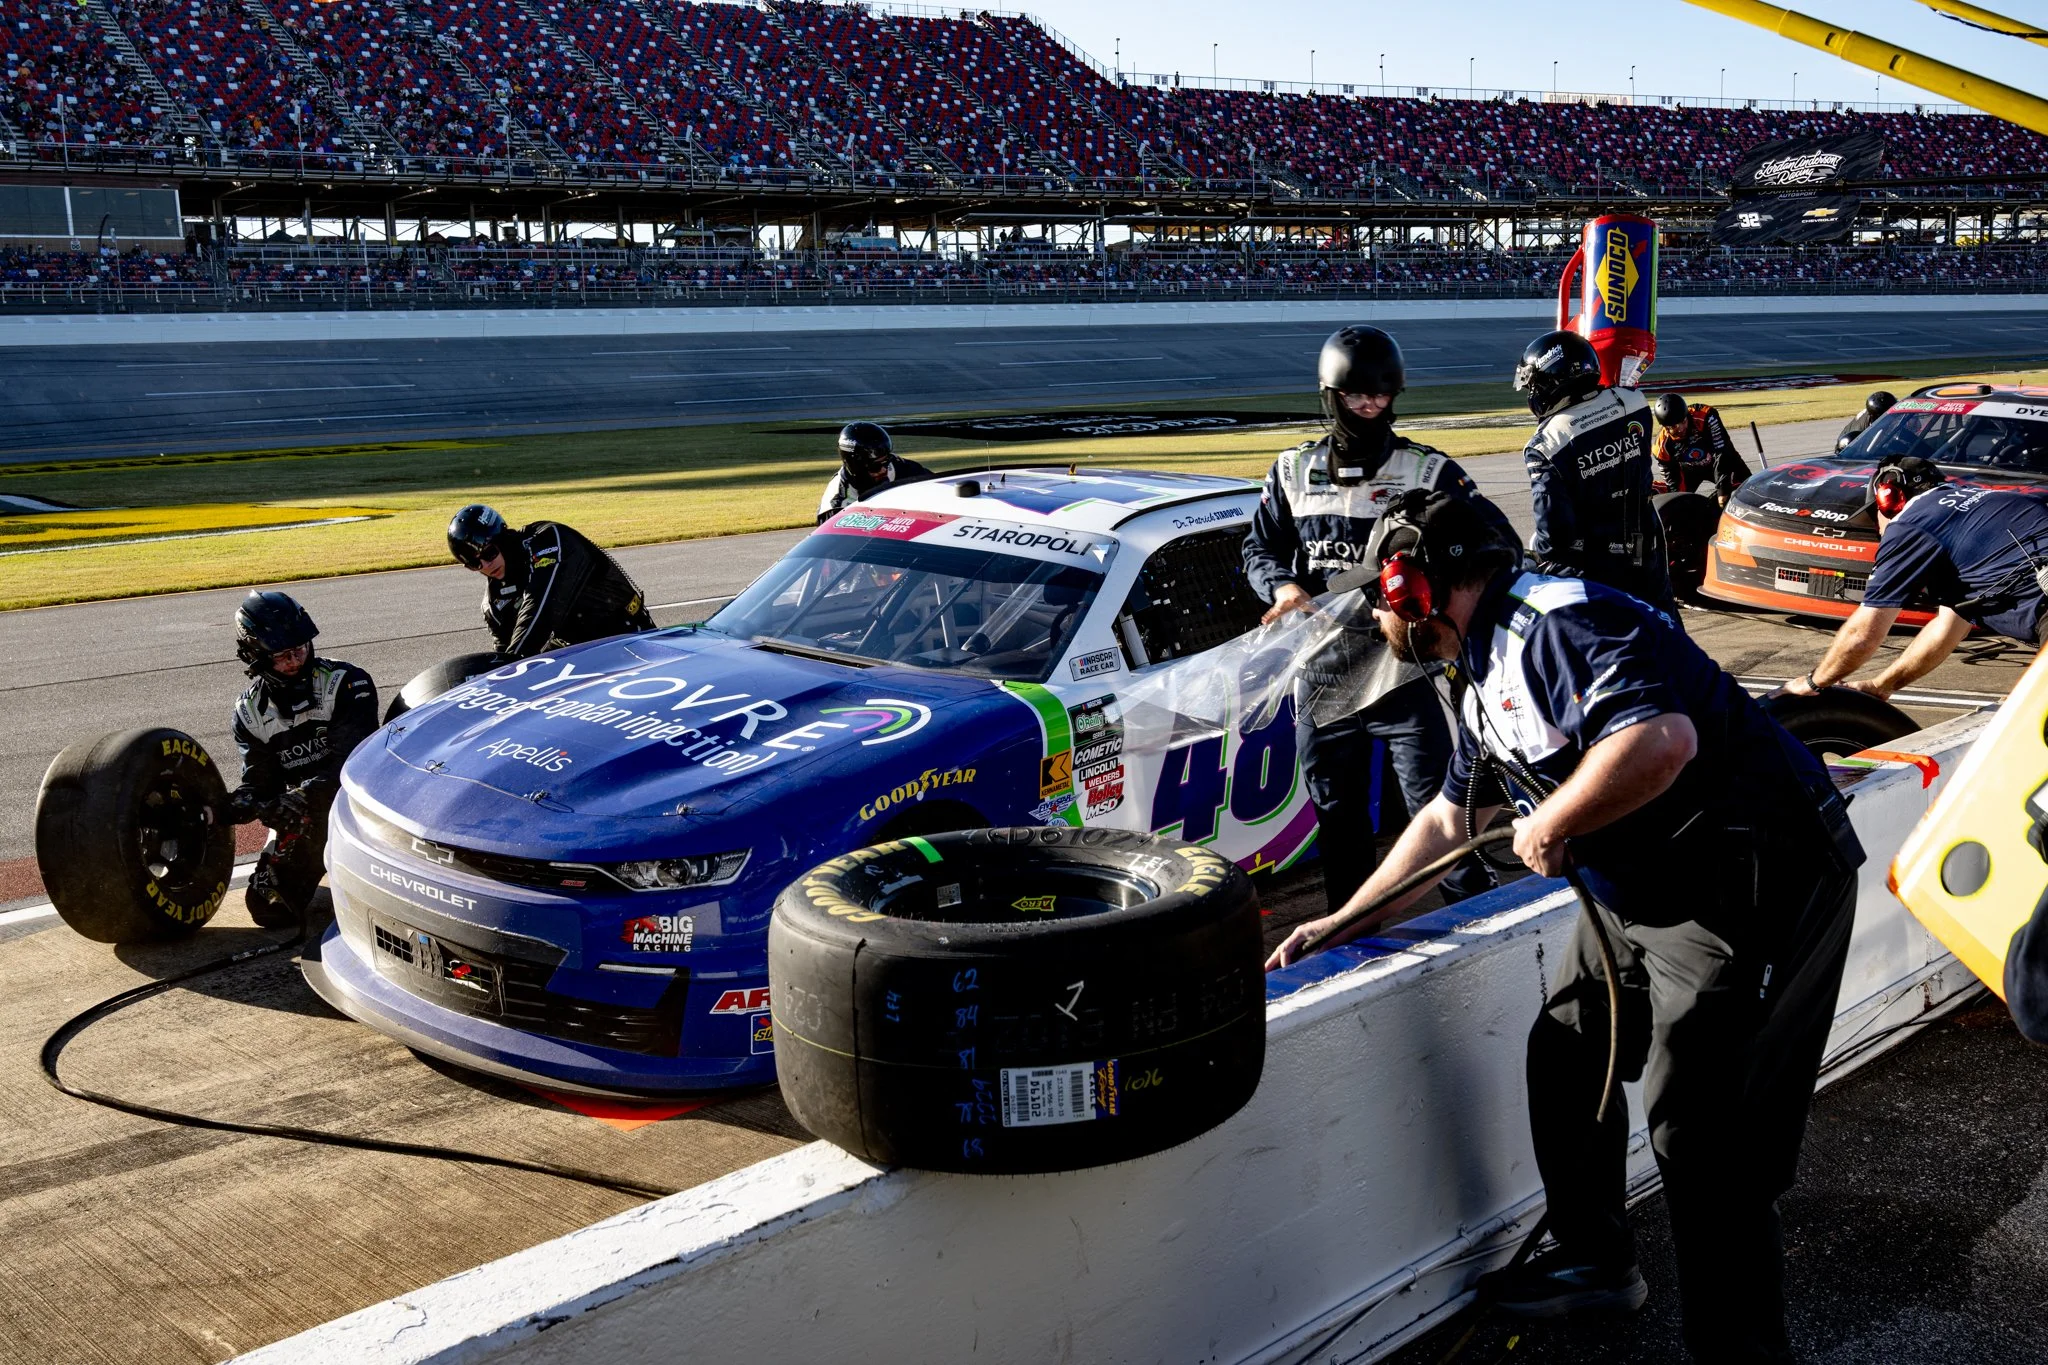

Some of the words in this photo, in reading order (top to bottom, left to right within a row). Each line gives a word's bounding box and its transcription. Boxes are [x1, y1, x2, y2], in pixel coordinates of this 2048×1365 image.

[1755, 159, 1796, 180] Jordan
[1793, 149, 1843, 170] Anderson
[1777, 167, 1815, 185] Racing
[1778, 190, 1817, 199] AUTOSPORT
[1738, 212, 1761, 229] 32
[1607, 232, 1628, 320] SUNOCO
[1534, 344, 1563, 369] Hendrick
[2015, 407, 2048, 418] DYE
[1577, 433, 1640, 469] SYFOVRE
[890, 517, 916, 526] AUTO
[1172, 519, 1188, 529] Dr.
[1185, 512, 1215, 527] Patrick
[1213, 507, 1244, 521] STAROPOLI
[1759, 501, 1799, 515] Race
[1810, 509, 1849, 522] Stop
[880, 523, 911, 533] PARTS
[953, 525, 1094, 557] STAROPOLI
[1305, 540, 1368, 560] SYFOV
[1783, 537, 1867, 553] CHEVROLET
[1080, 666, 1099, 676] RACE
[1101, 661, 1114, 670] CAR
[1086, 652, 1113, 667] NASCAR
[161, 739, 209, 767] EAGLE
[476, 737, 573, 772] Apellis
[622, 712, 777, 776] injection)
[1074, 738, 1123, 765] COMETIC
[1150, 648, 1299, 845] 48
[1080, 759, 1117, 780] LINCOLN
[1088, 771, 1120, 787] WELDERS
[859, 768, 977, 821] GOODYEAR
[1041, 781, 1070, 797] KENNAMETAL
[1087, 782, 1124, 807] Holley
[1086, 798, 1119, 820] MSD
[802, 840, 908, 922] GOODYEAR
[1173, 846, 1227, 897] EAGLE
[370, 863, 477, 911] CHEVROLET
[146, 880, 226, 924] GOODYEAR
[658, 916, 694, 933] BIG
[633, 933, 692, 944] MACHINE
[633, 944, 691, 952] RACING
[953, 968, 980, 993] 62
[713, 988, 771, 1010] AR
[955, 1004, 979, 1028] 84
[1097, 1066, 1107, 1111] Racing
[1106, 1060, 1118, 1116] GOODYEAR
